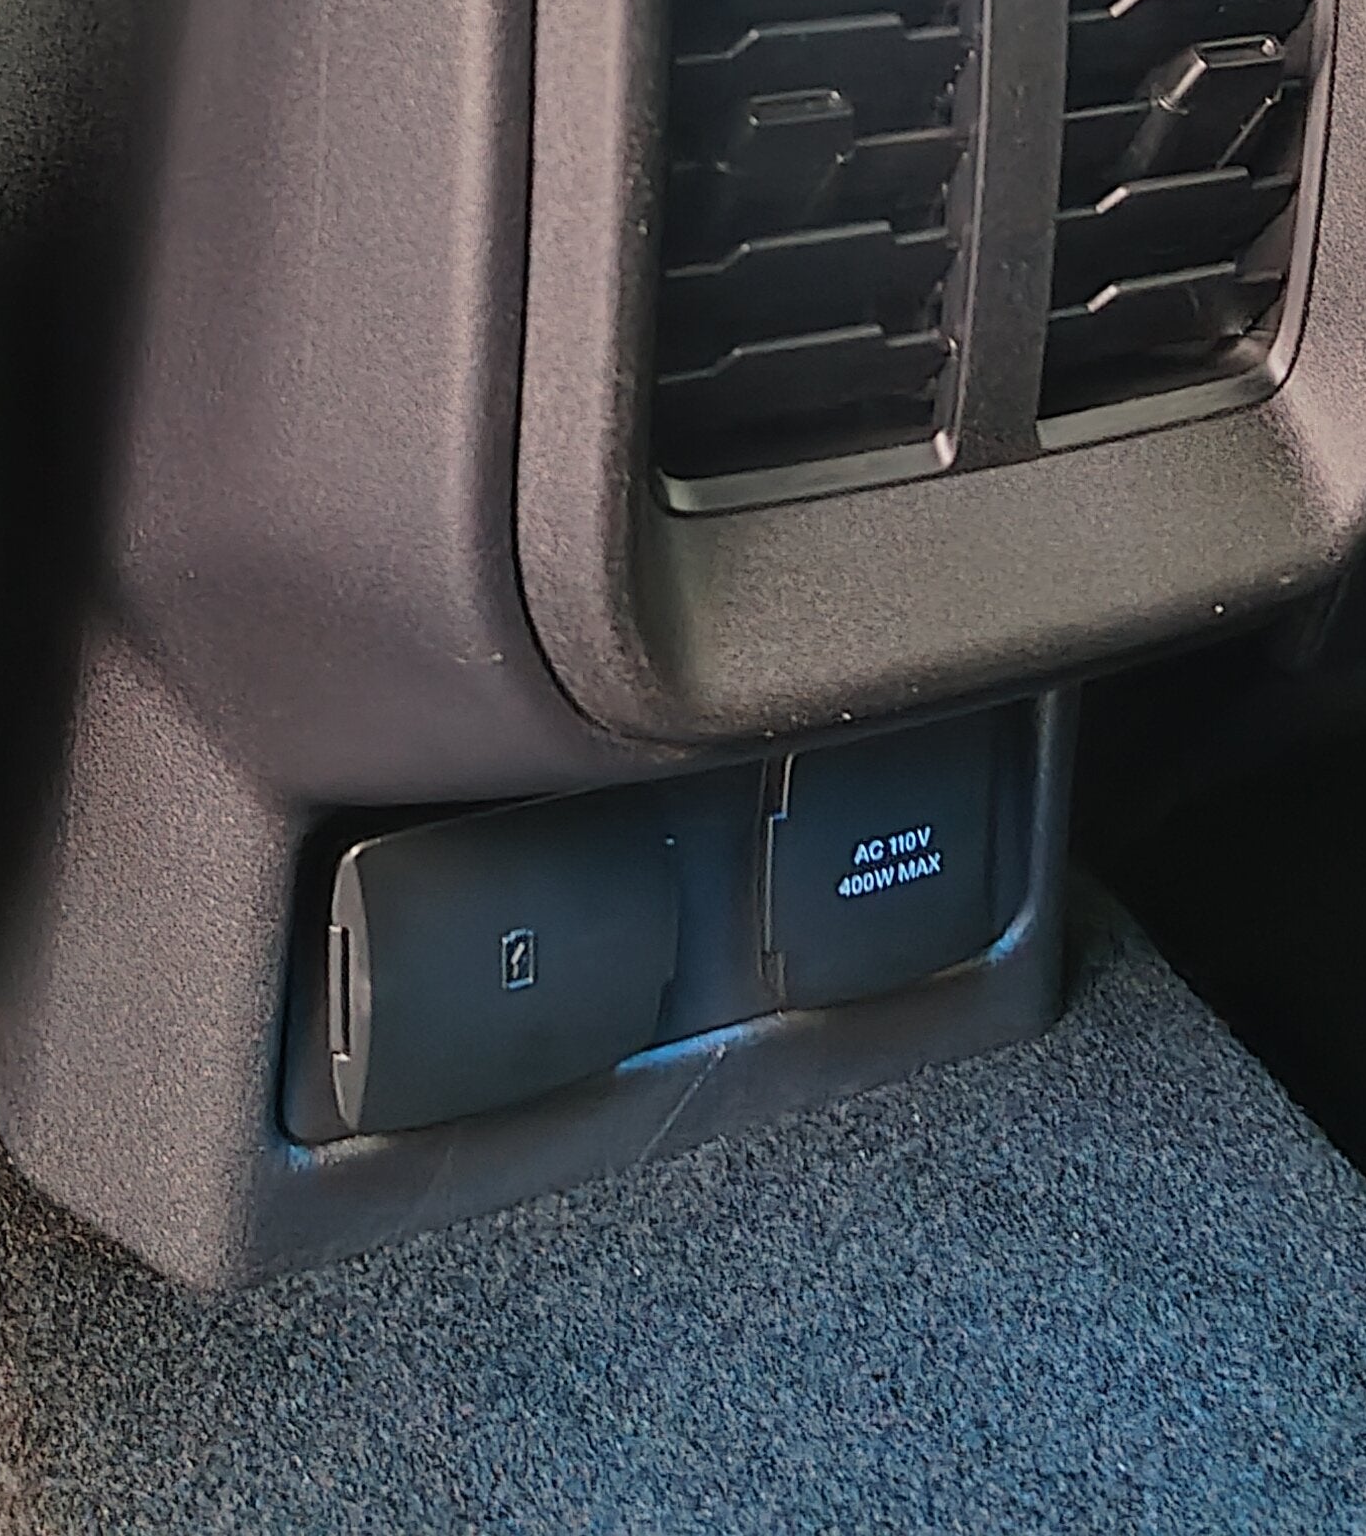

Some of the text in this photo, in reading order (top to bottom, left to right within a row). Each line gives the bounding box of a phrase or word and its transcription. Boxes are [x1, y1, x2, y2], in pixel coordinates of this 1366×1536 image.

[853, 825, 932, 866] AC 110V
[837, 851, 942, 898] 400W MAX
